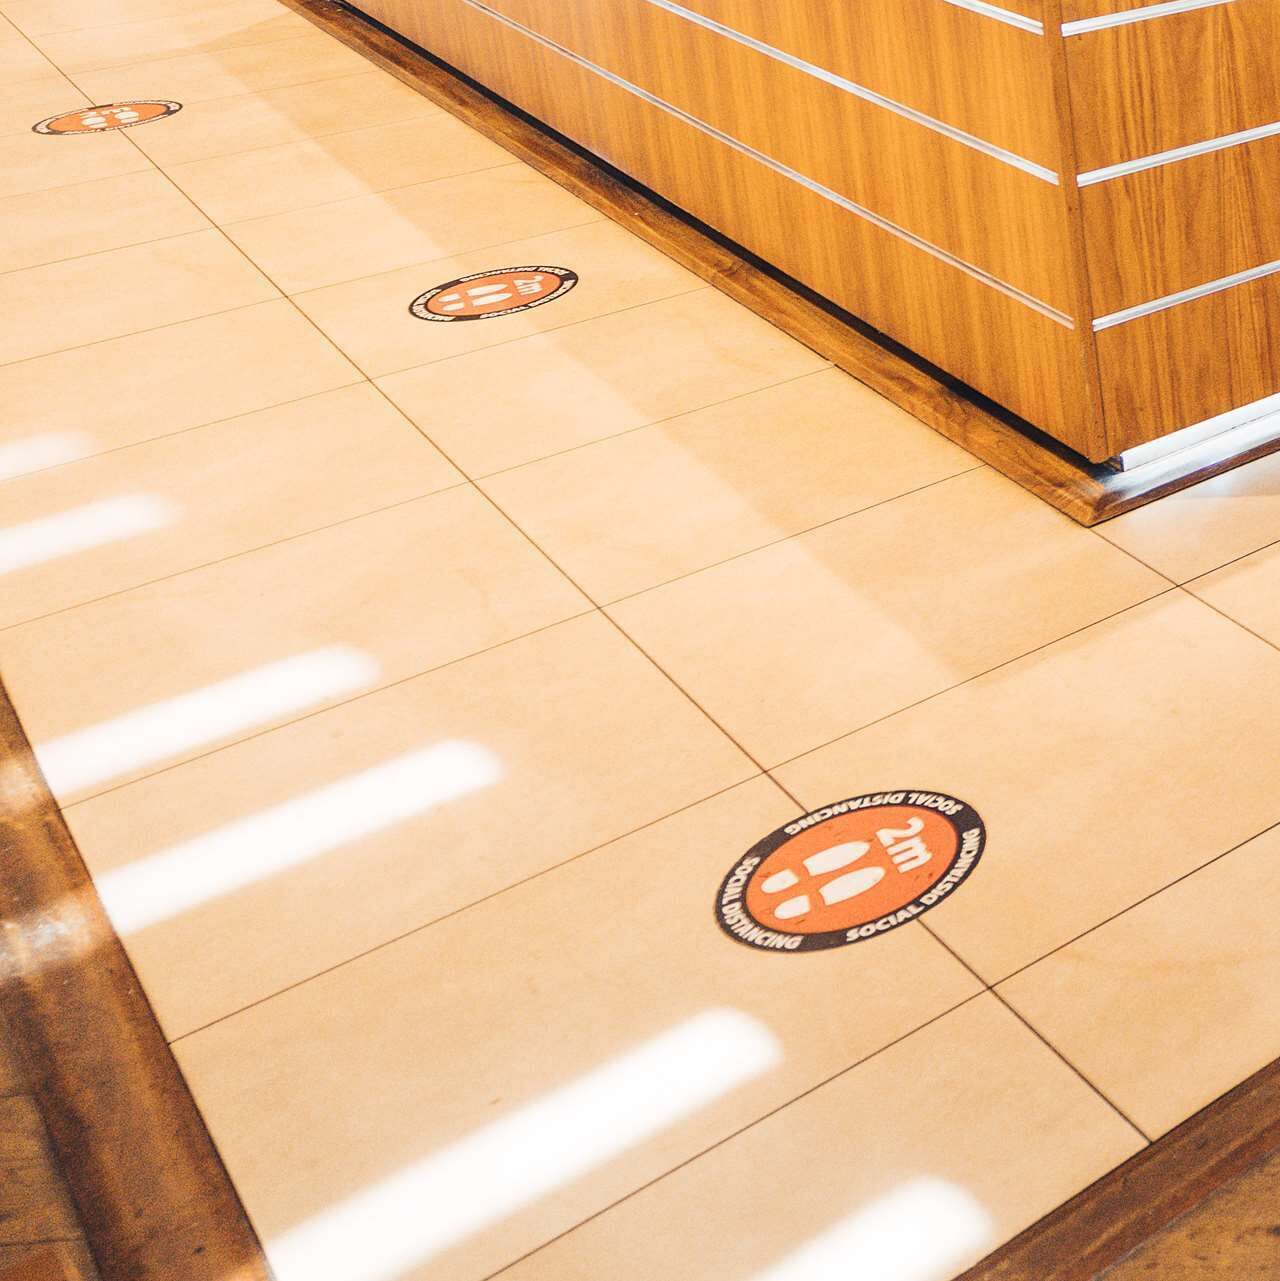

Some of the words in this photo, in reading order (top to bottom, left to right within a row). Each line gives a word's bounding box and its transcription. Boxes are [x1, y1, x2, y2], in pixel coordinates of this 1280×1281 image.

[784, 792, 907, 836] DISTANCING
[908, 792, 964, 816] SOCIAL
[875, 816, 933, 874] 2m
[721, 856, 760, 907] SOCIAL
[845, 902, 926, 943] SOCIAL
[926, 827, 981, 906] DISTANCING
[721, 904, 804, 950] DISTANCING
